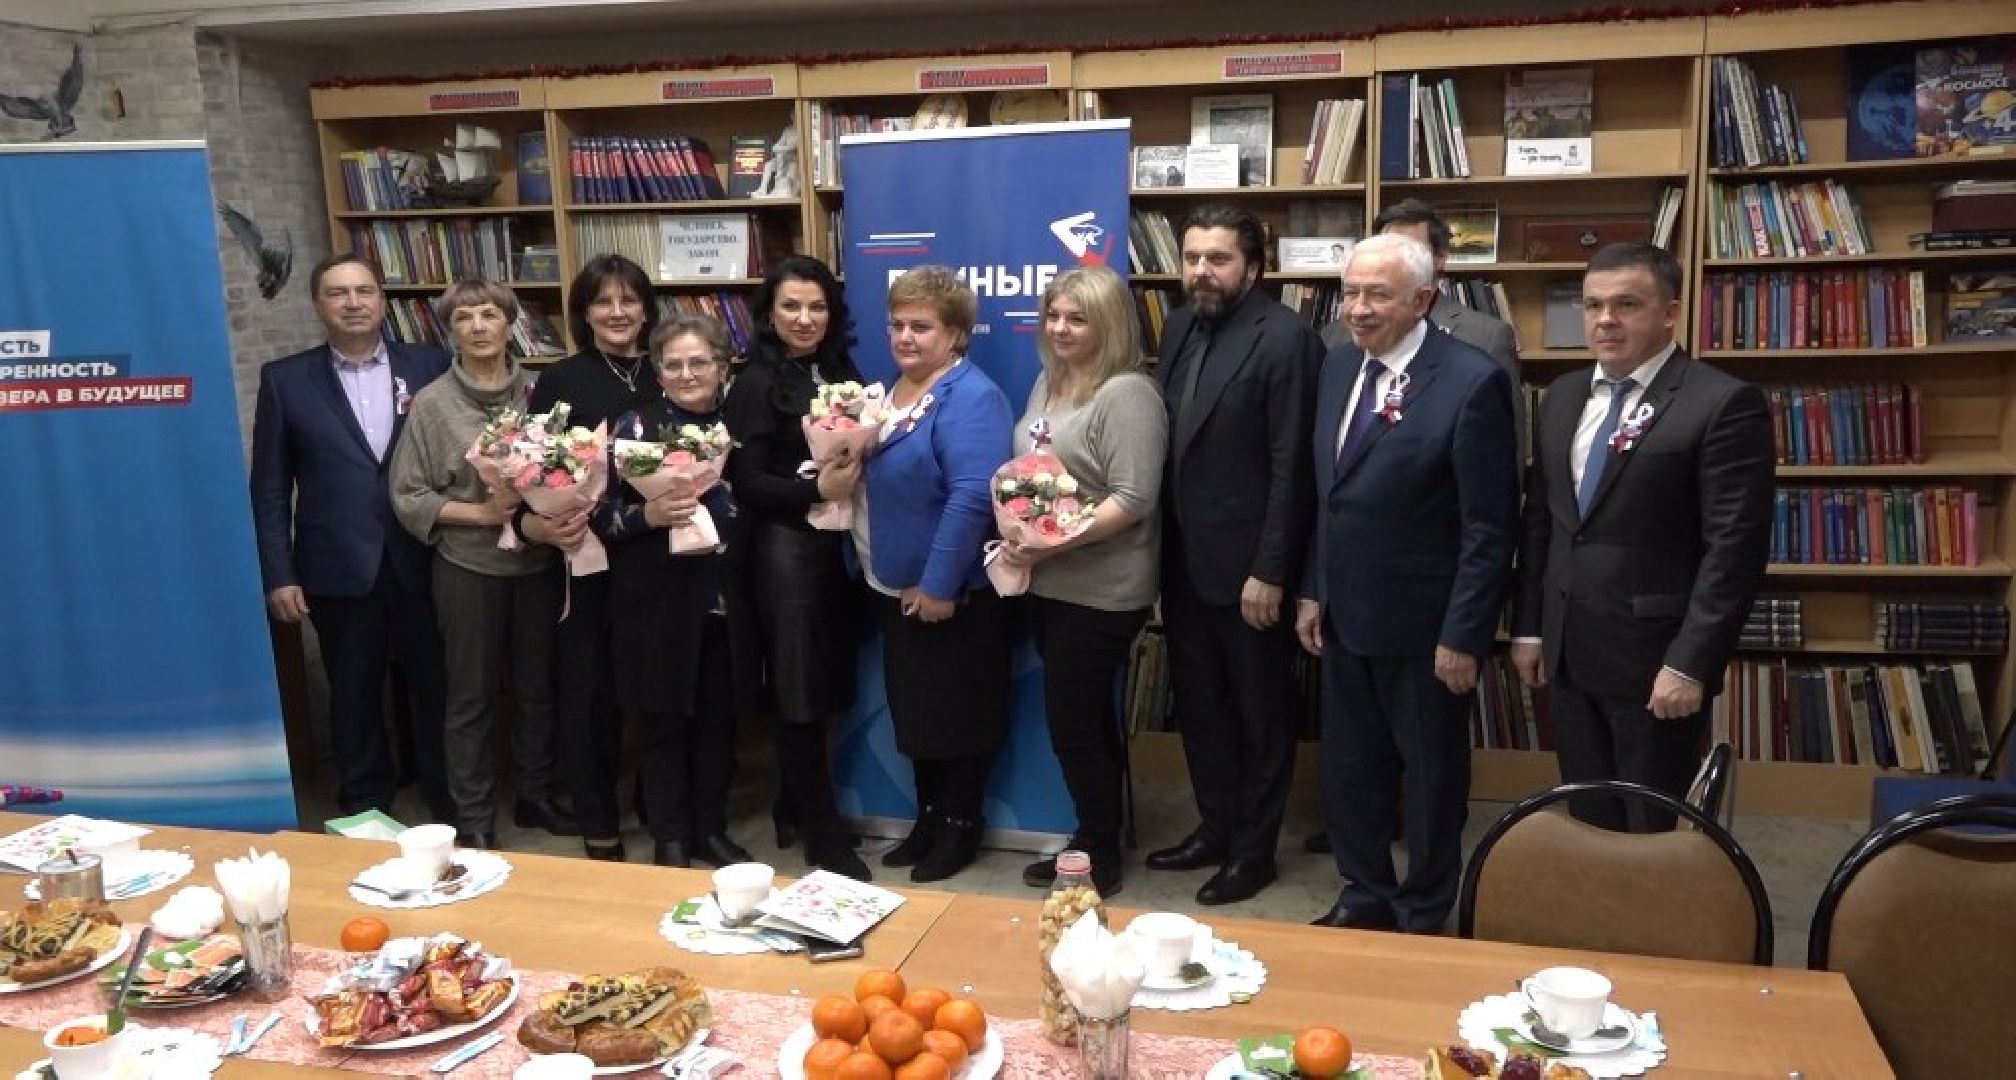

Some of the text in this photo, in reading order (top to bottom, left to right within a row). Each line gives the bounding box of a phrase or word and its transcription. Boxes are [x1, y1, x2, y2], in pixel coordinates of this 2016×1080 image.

[0, 340, 41, 354] СТЬ
[57, 388, 73, 403] В
[79, 384, 185, 403] БУДУЩЕЕ
